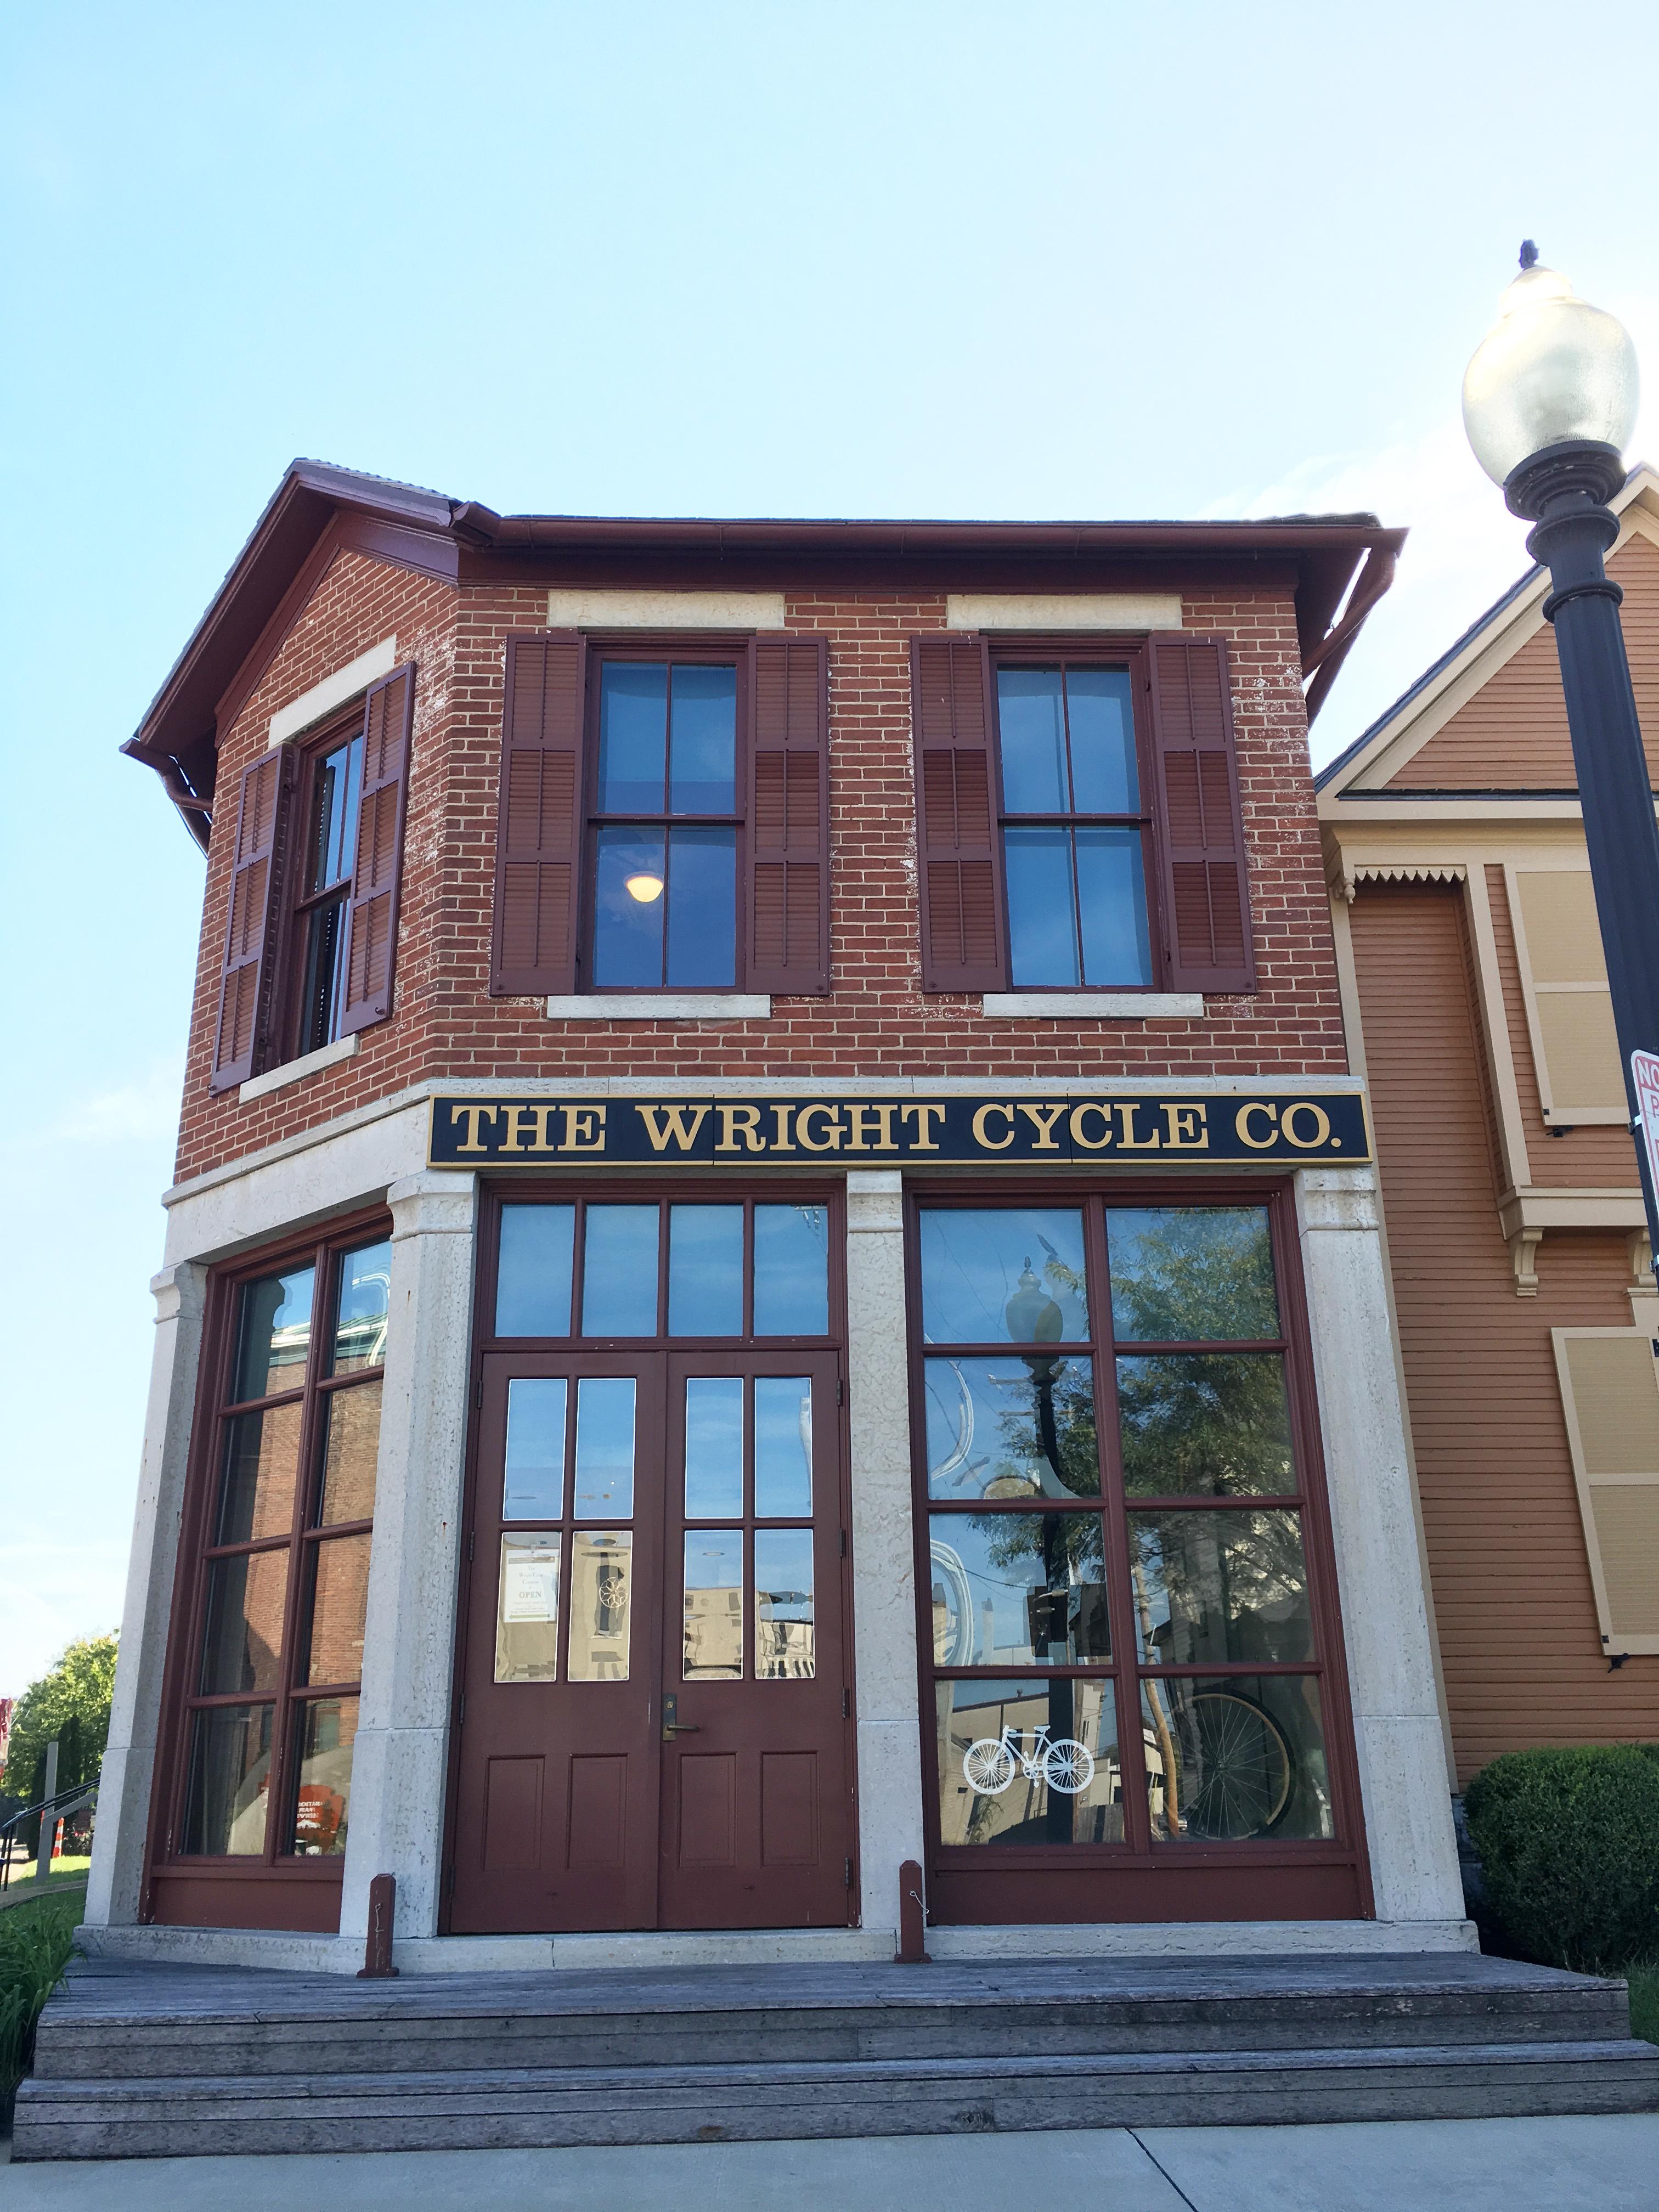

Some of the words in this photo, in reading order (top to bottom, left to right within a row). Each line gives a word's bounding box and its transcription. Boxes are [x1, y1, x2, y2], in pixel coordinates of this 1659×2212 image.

[452, 1105, 606, 1152] THE
[635, 1104, 946, 1152] WRIGHT
[972, 1103, 1209, 1149] CYCLE
[1235, 1102, 1341, 1148] CO.
